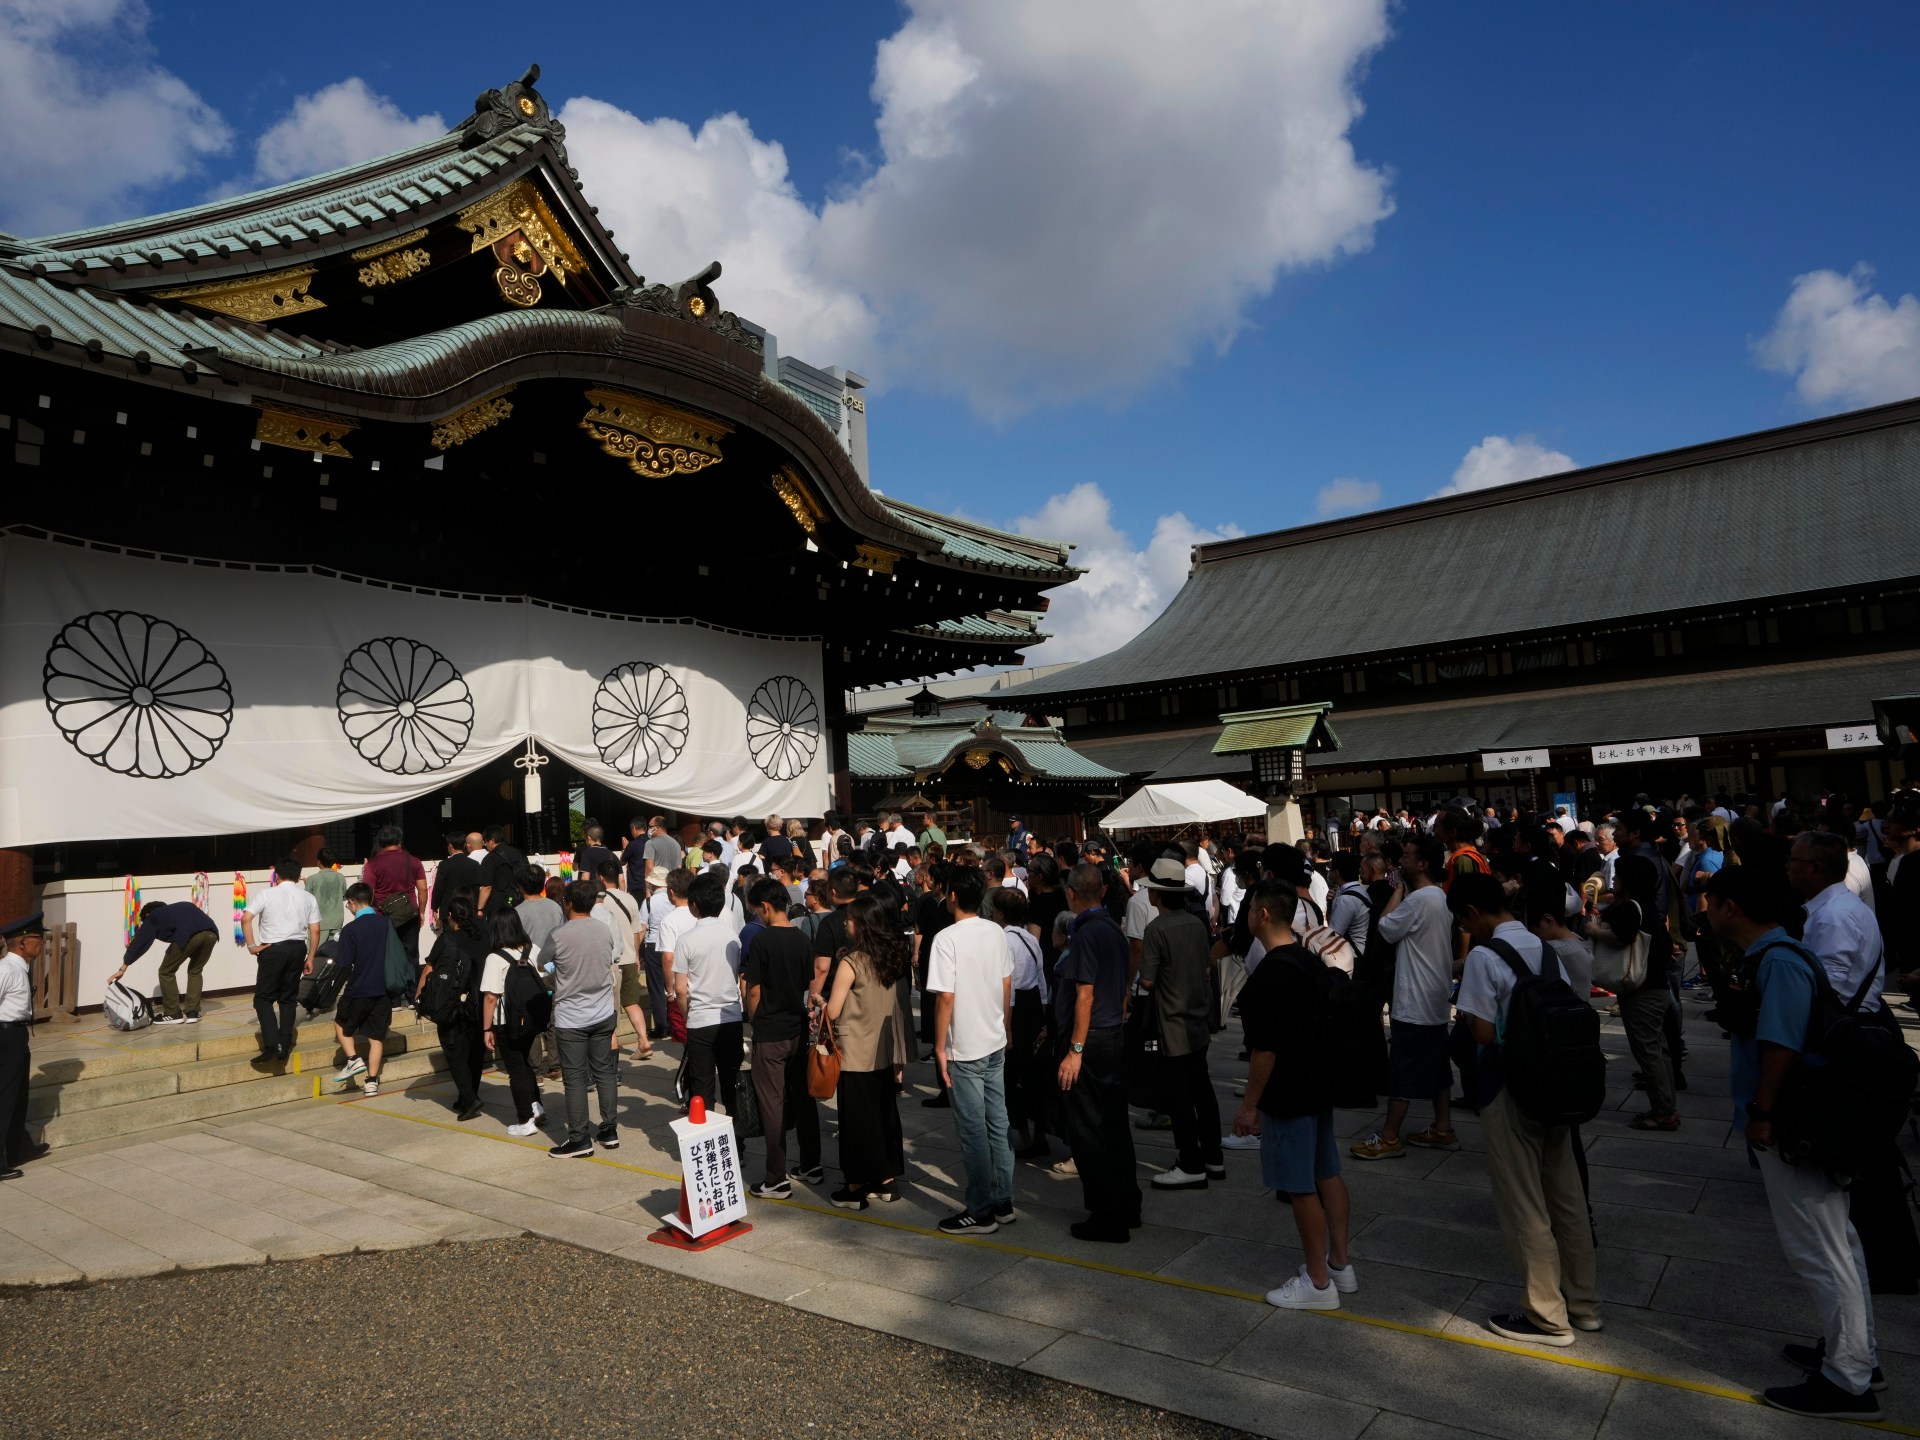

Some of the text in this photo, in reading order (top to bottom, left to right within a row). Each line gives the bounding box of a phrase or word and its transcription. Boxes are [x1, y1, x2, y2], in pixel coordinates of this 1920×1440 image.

[1497, 755, 1534, 766] 朱印所
[1842, 732, 1877, 743] おみ
[690, 1142, 709, 1196] び下さい。
[703, 1137, 726, 1214] 列後方にお並
[717, 1133, 739, 1207] 御参拝の方は
